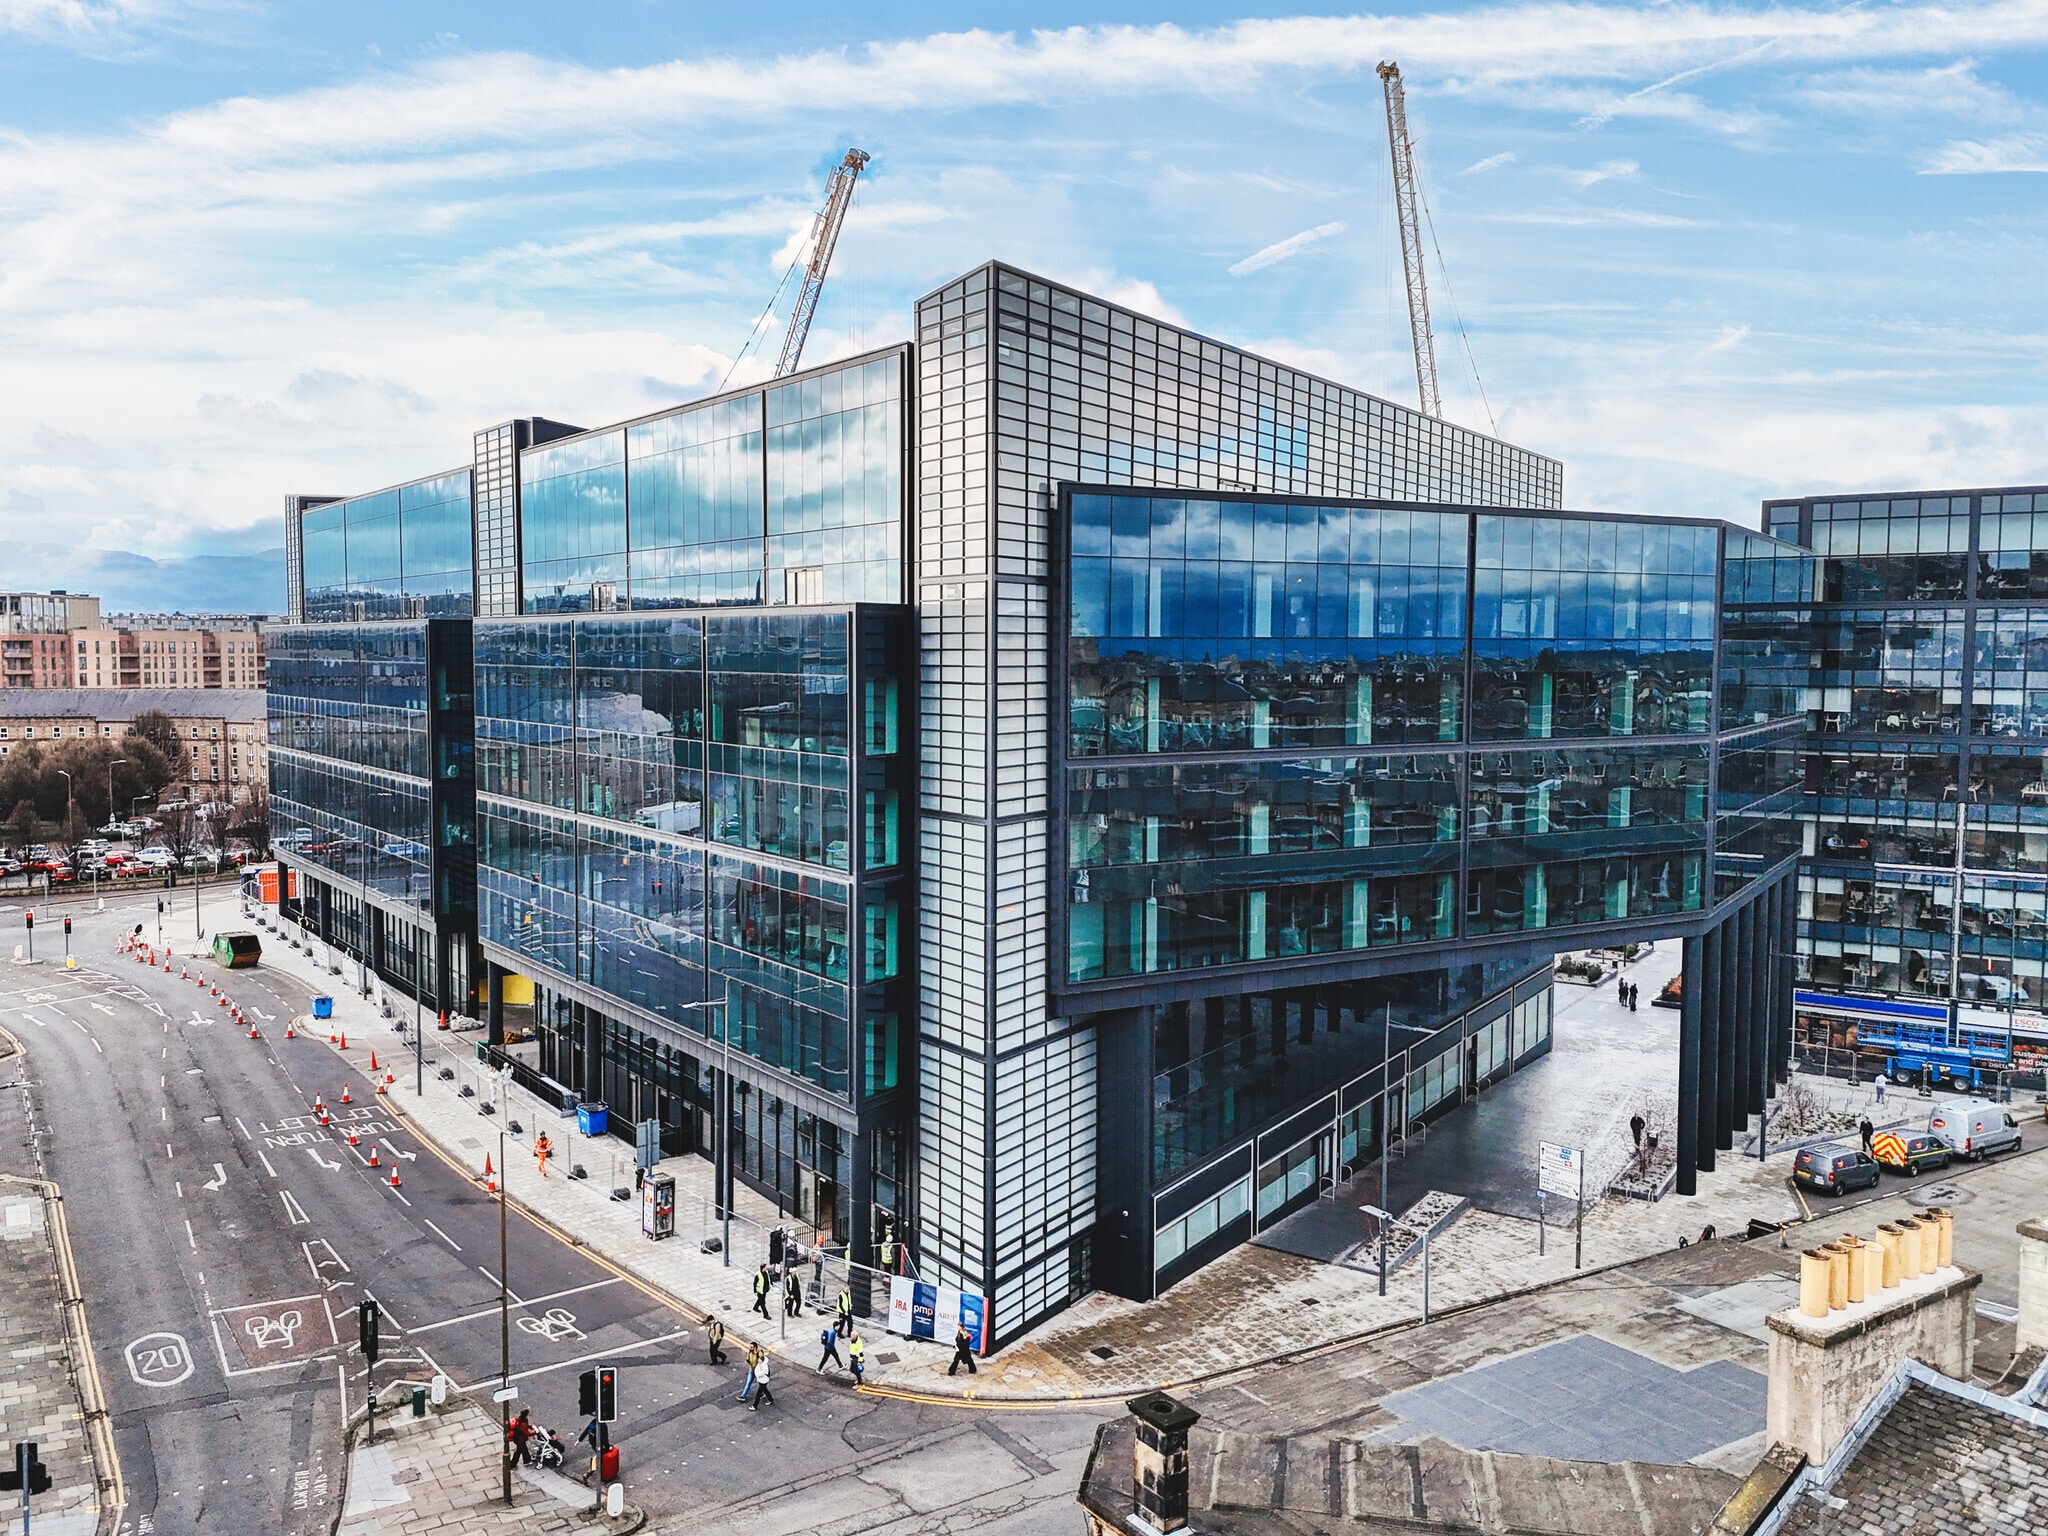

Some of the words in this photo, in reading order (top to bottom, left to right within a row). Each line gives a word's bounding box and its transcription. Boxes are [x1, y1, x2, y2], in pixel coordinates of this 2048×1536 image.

[2012, 1018, 2040, 1027] ESCO
[329, 1106, 388, 1124] LEFT
[259, 1115, 320, 1134] LEFT
[264, 1130, 333, 1149] TURN
[913, 1304, 934, 1317] pmp
[937, 1312, 957, 1321] ARUP
[136, 1345, 182, 1374] 20
[313, 1473, 328, 1498] WAYS
